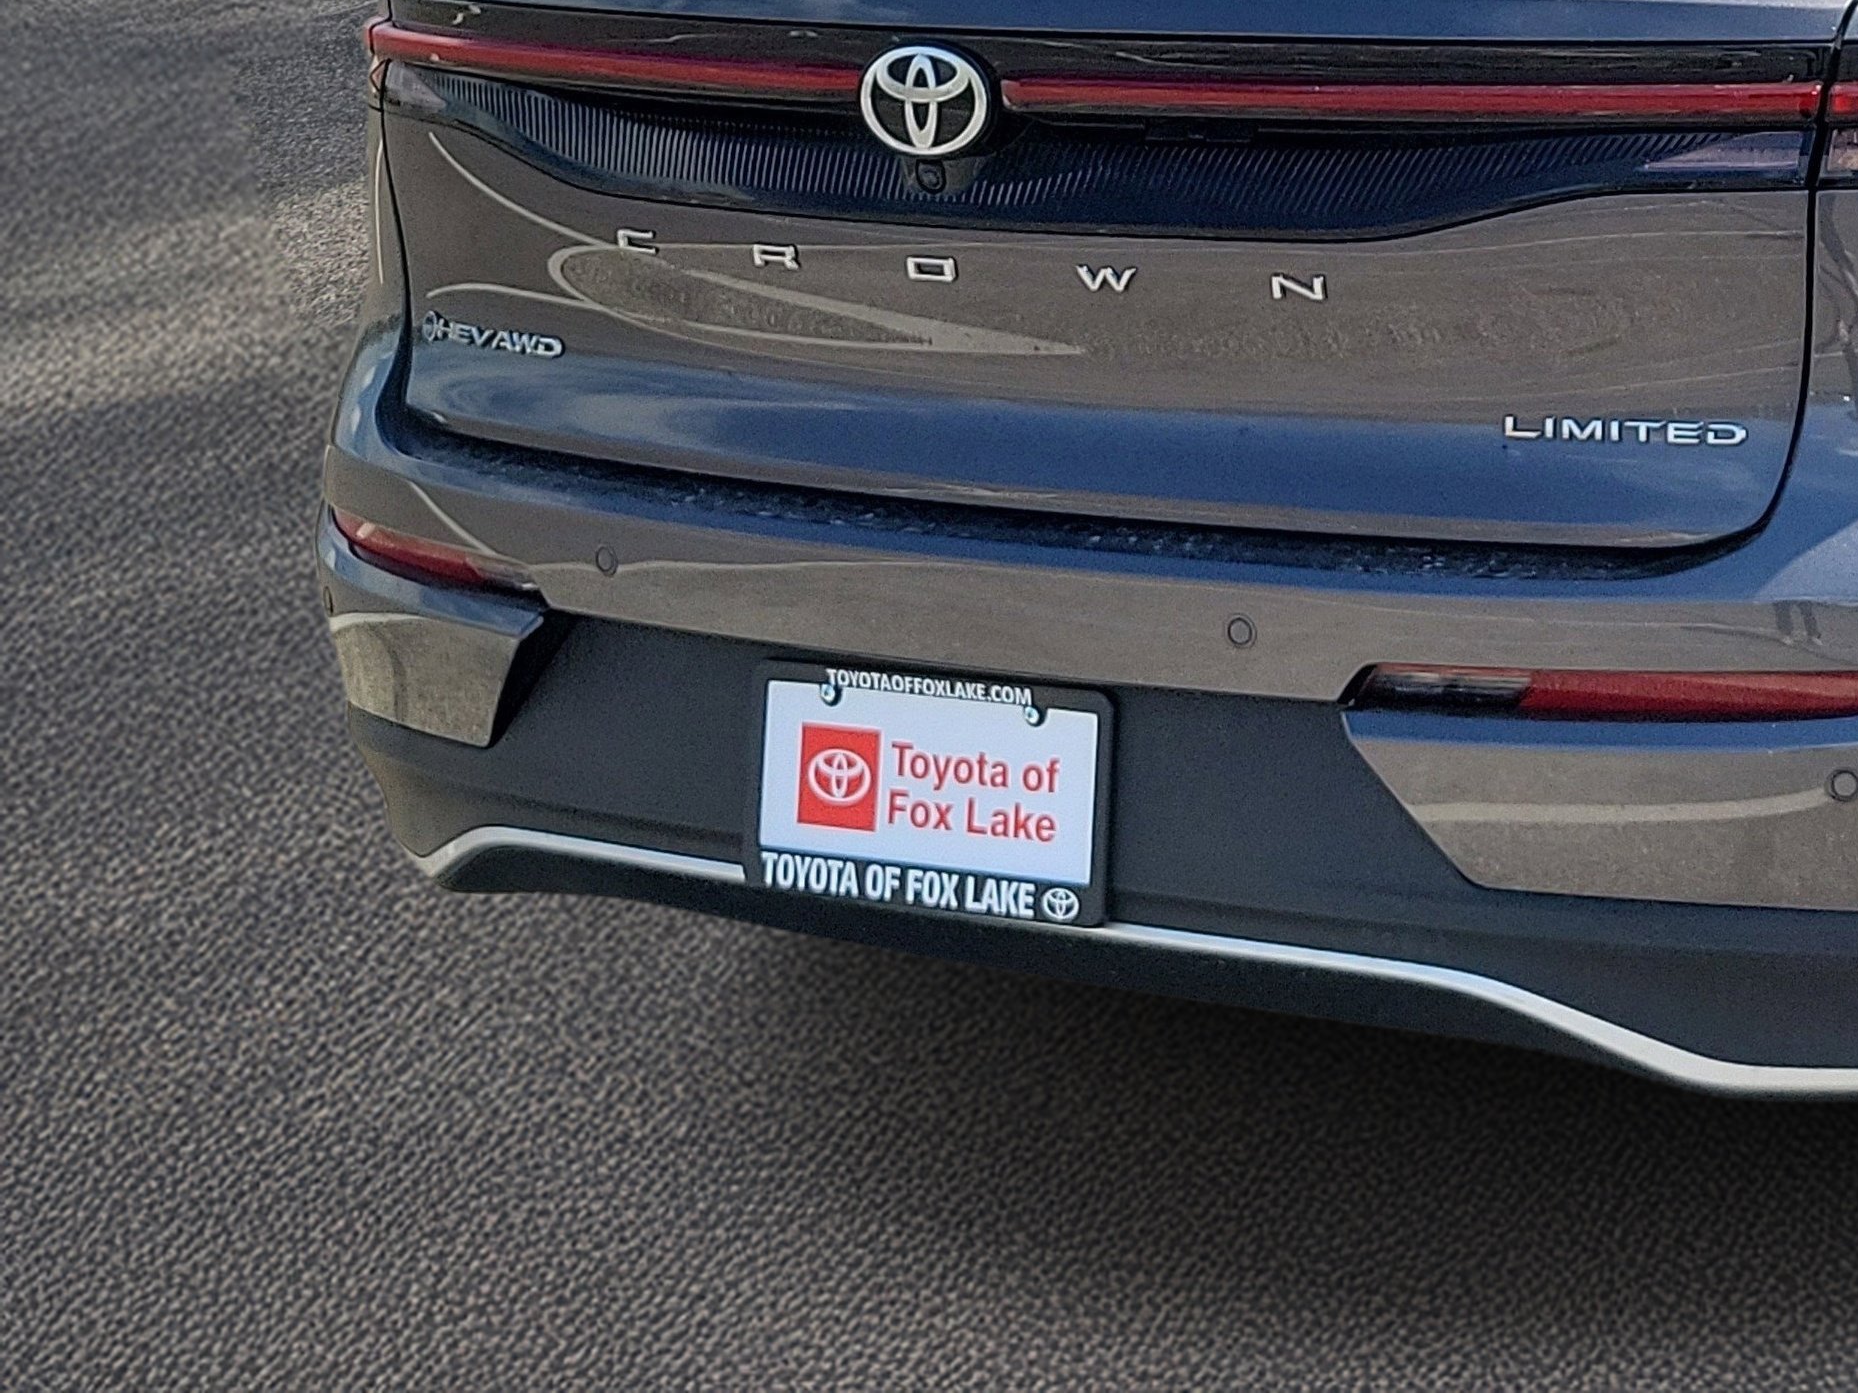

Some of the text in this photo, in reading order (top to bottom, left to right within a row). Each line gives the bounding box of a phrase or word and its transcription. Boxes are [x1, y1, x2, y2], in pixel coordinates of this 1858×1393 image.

[616, 228, 1325, 301] CROWN
[1503, 415, 1747, 446] LIMITED
[825, 668, 1032, 705] TOYOTAOFFOXLAKE.COM
[892, 741, 1059, 793] Toyota of
[887, 789, 1057, 843] Fox Lake
[761, 851, 1036, 918] TOYOTA OF FOX LAKE
